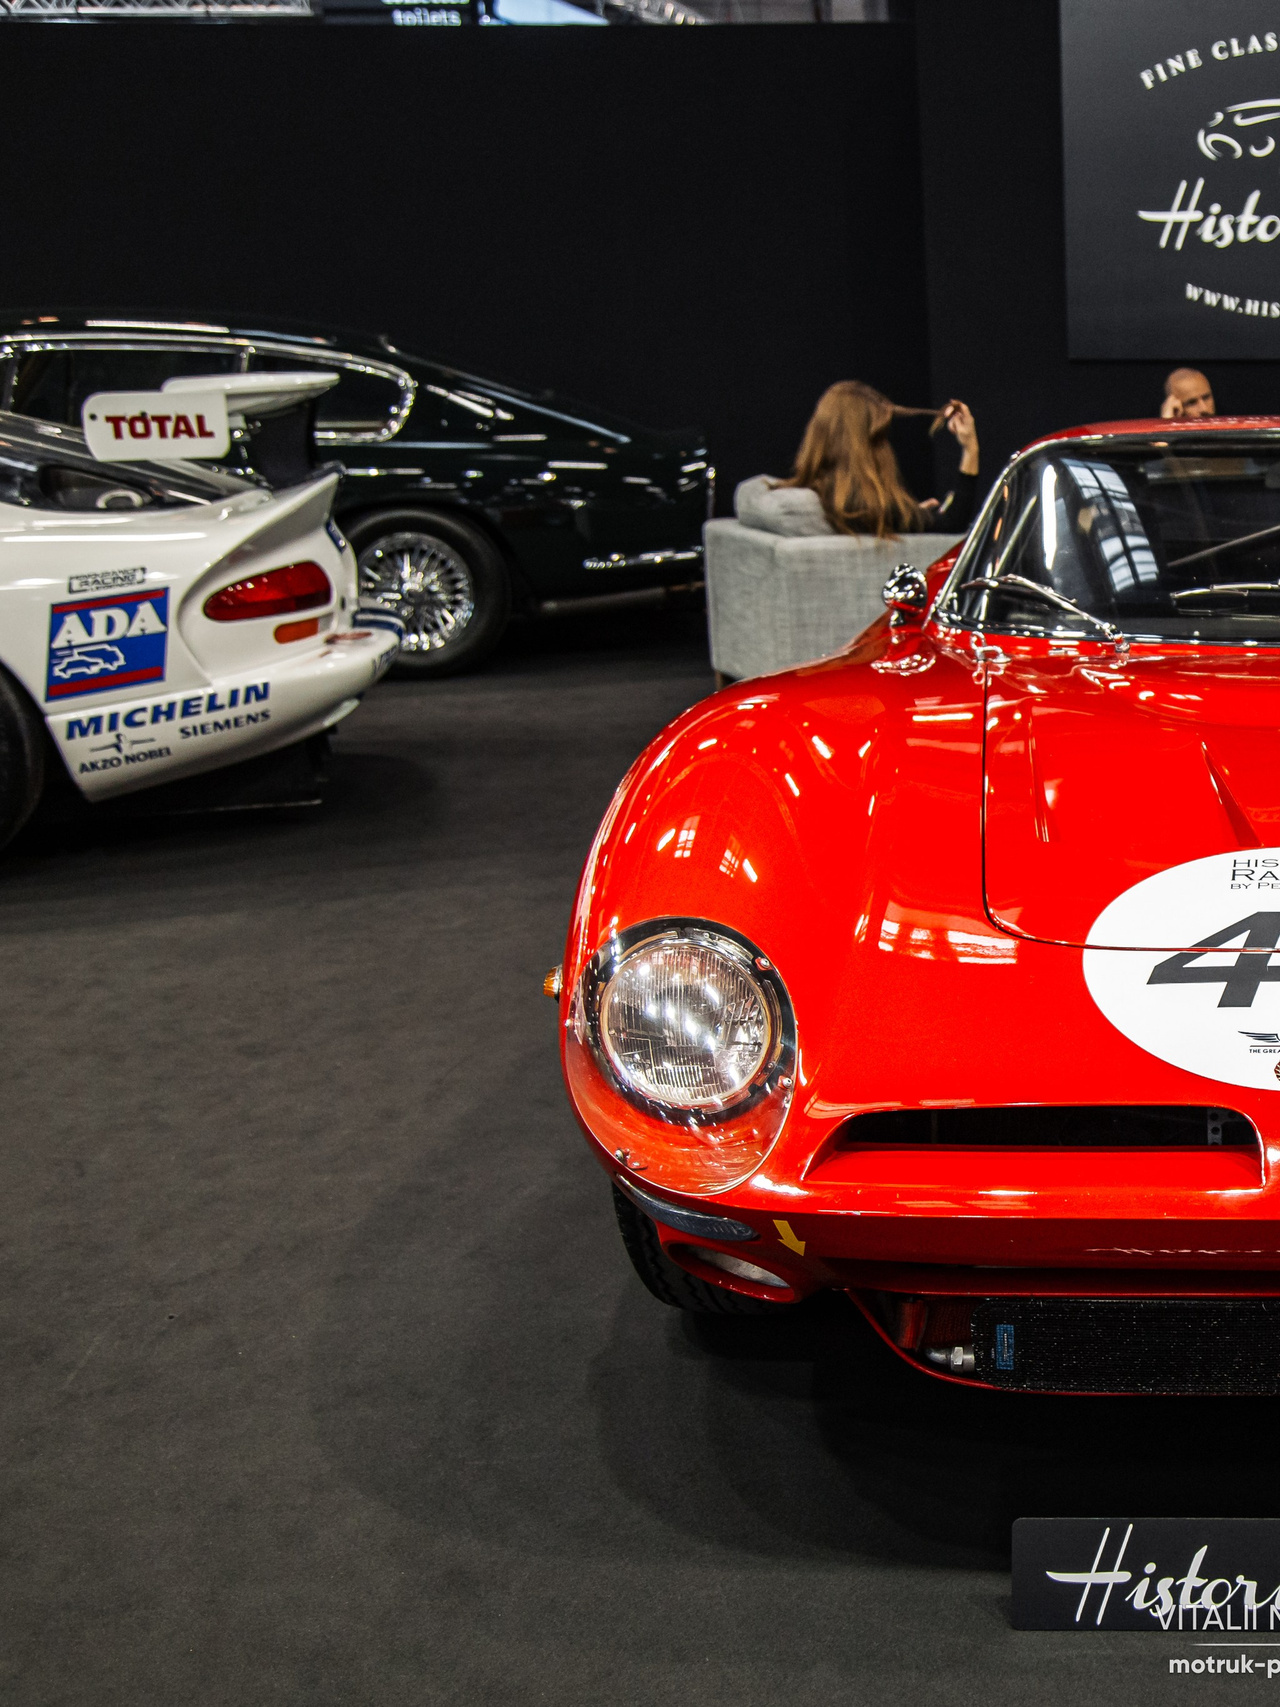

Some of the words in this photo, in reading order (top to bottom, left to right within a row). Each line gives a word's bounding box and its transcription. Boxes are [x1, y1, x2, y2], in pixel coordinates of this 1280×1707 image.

[392, 7, 461, 26] toilets
[1139, 48, 1203, 90] FINE
[105, 413, 215, 441] TOTAL
[51, 601, 167, 650] ADA
[66, 682, 270, 741] MICHELIN
[178, 709, 271, 740] SIEMENS
[79, 756, 122, 774] AKZO
[125, 746, 172, 765] NOBEL
